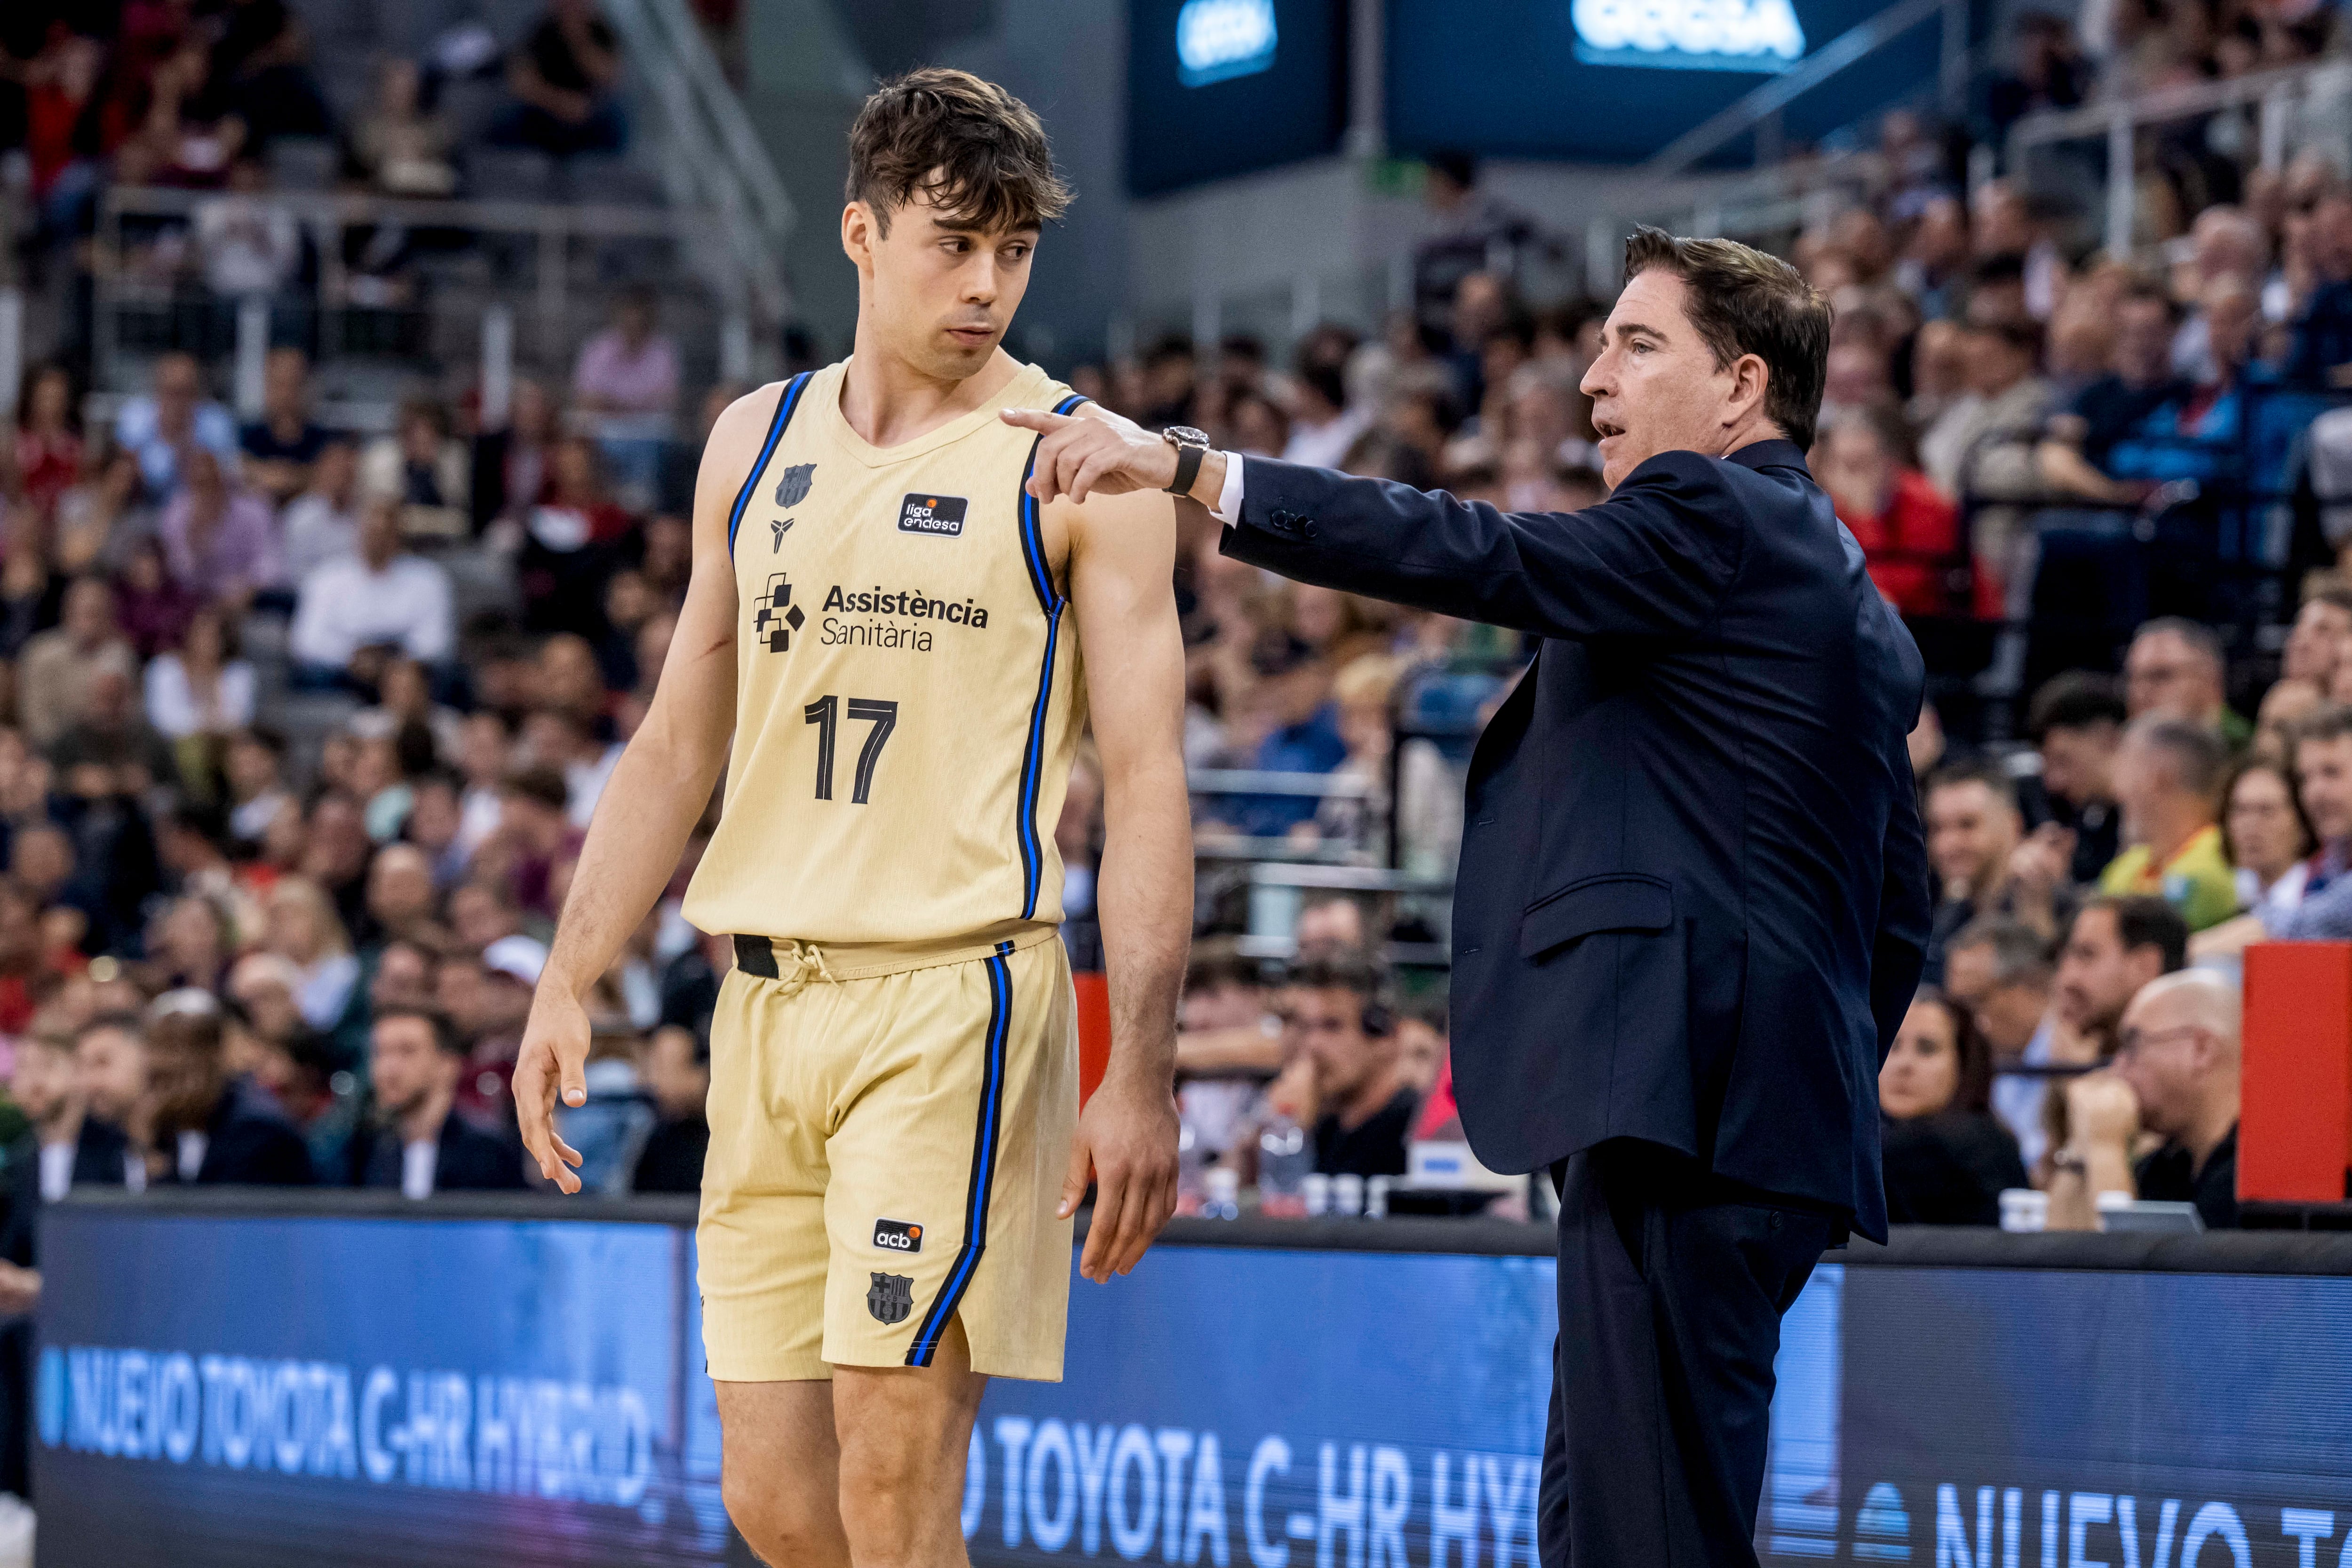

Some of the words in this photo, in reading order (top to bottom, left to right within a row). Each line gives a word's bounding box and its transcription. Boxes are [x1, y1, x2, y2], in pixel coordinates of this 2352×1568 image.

[904, 517, 960, 532] endesa
[906, 503, 932, 517] liga
[822, 585, 989, 629] Assistència
[820, 617, 933, 652] Sanitària
[804, 694, 898, 804] 17
[877, 1232, 911, 1249] acb
[993, 1415, 1229, 1567] TOYOTA
[1244, 1433, 1412, 1568] C-HR
